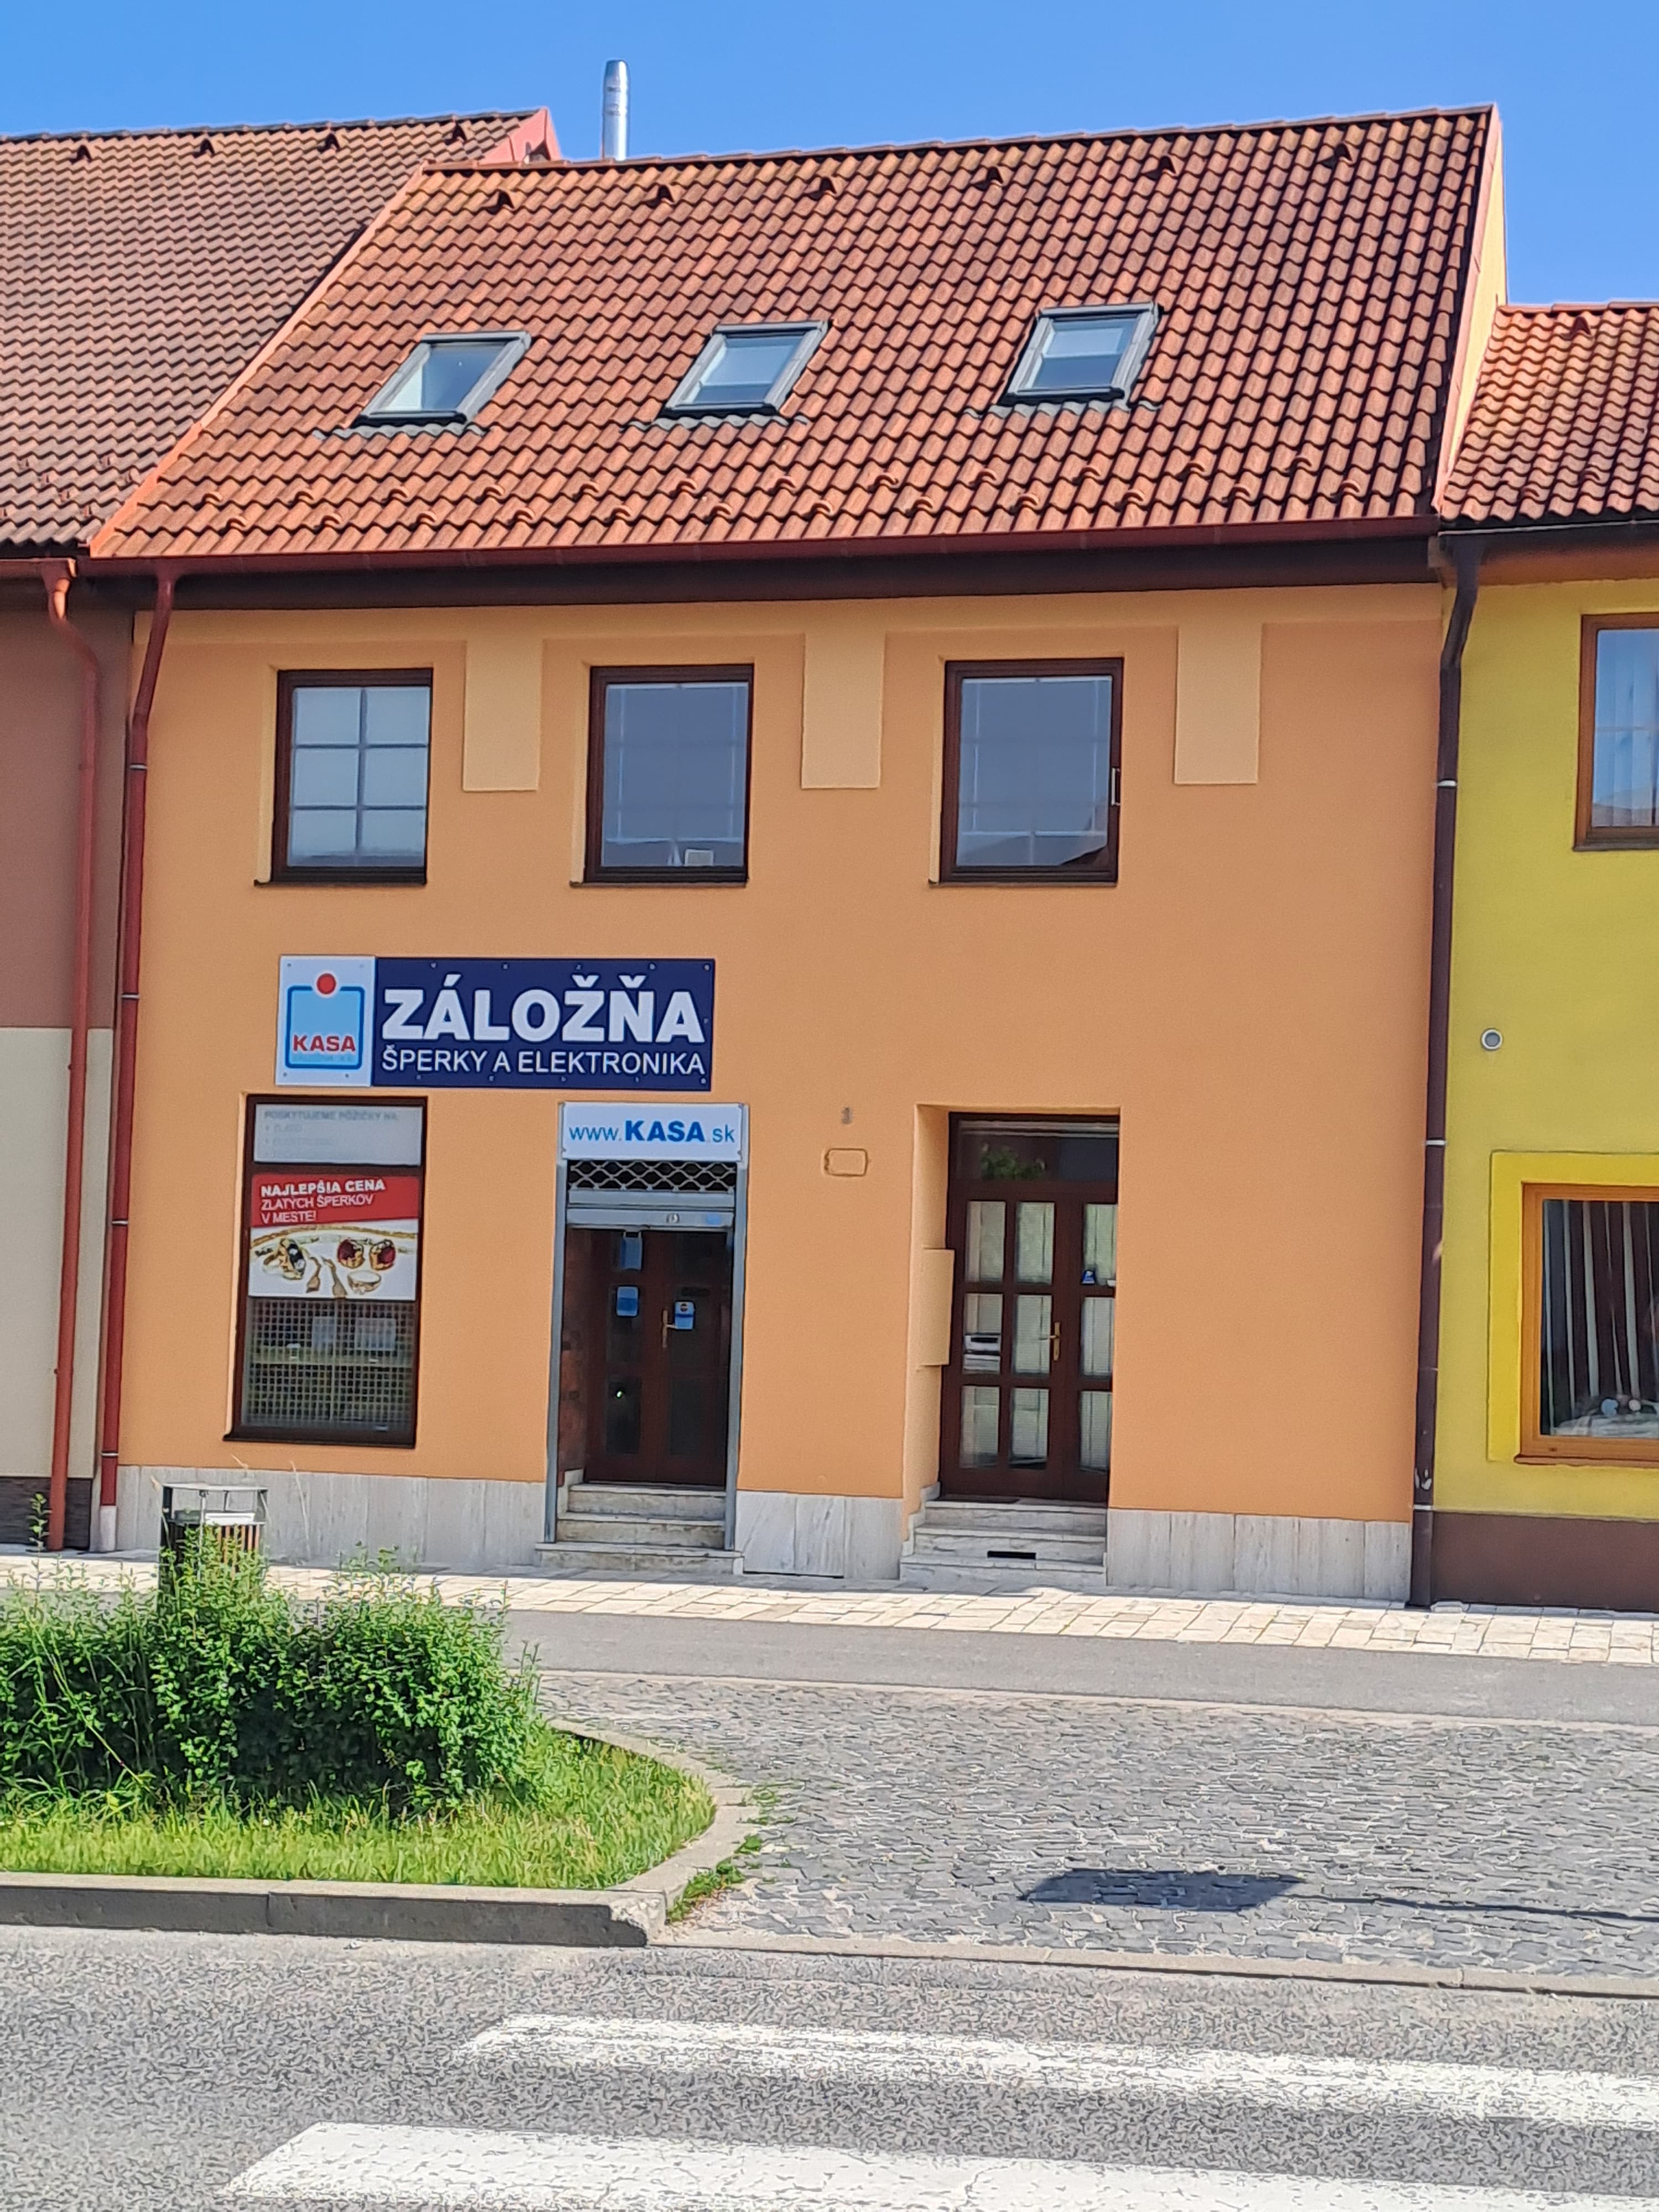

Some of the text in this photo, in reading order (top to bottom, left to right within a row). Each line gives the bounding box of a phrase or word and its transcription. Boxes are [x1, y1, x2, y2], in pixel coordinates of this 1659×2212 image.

[382, 973, 704, 1044] ZÁLOŽŇA
[293, 1034, 356, 1052] KASA
[382, 1045, 705, 1076] ŠPERKY A ELEKTRONIKA
[261, 1178, 385, 1197] NAJLEPŠIA CENA
[261, 1194, 374, 1211] ZLATÝCH ŠPERKOV
[261, 1210, 316, 1224] V MESTE!
